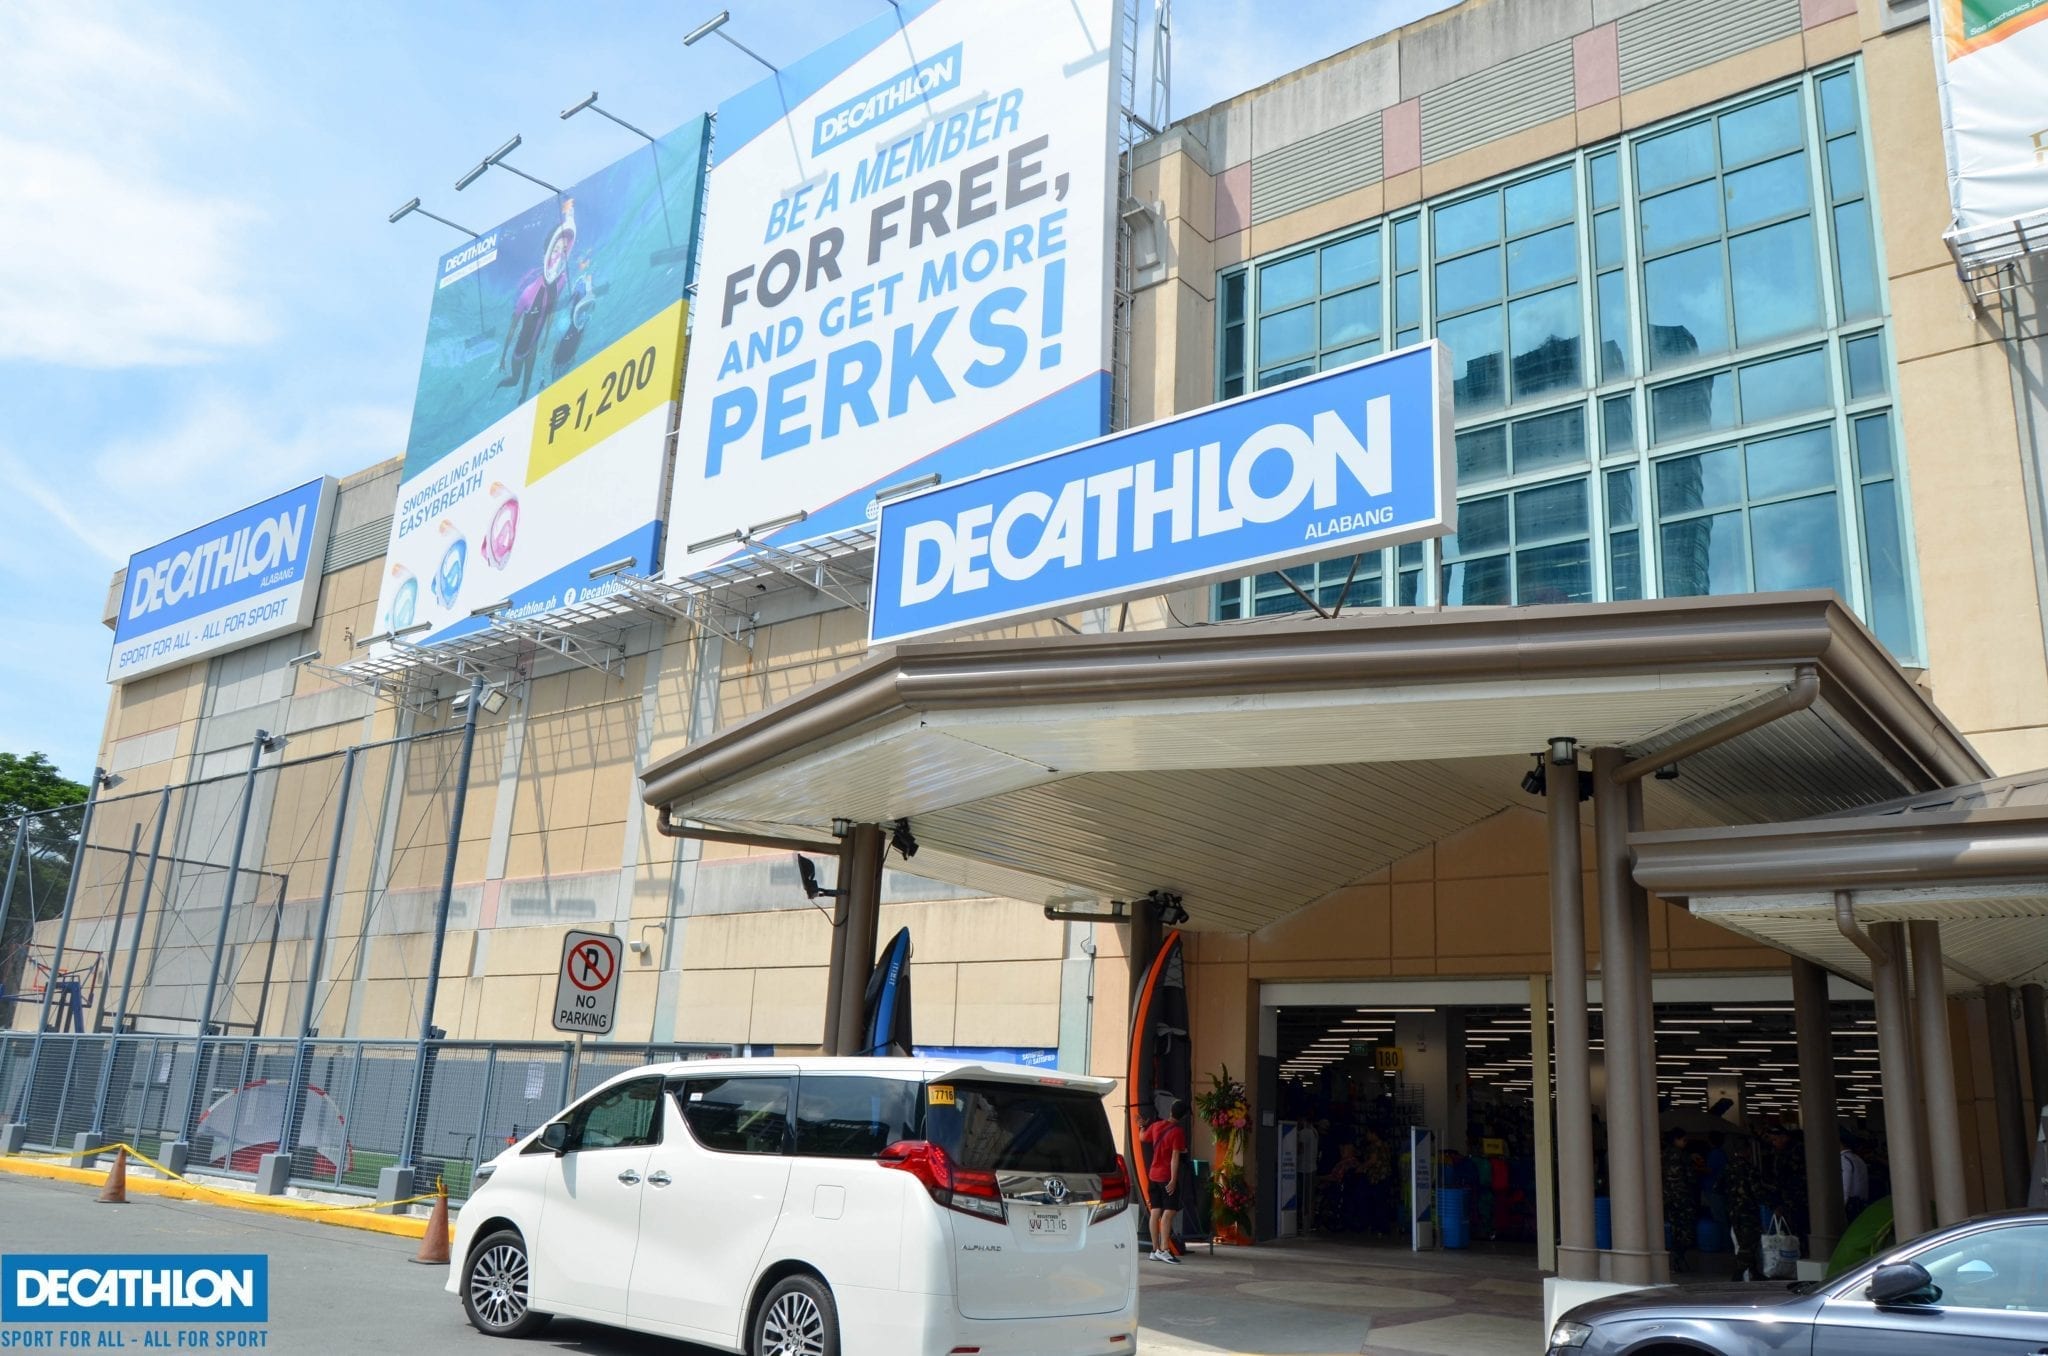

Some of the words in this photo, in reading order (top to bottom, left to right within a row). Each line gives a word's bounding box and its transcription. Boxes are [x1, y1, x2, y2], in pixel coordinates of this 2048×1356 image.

[1970, 24, 1987, 36] See
[1988, 2, 2031, 27] mechanics
[819, 56, 954, 145] DECATHLON
[763, 184, 814, 244] BE
[815, 171, 840, 221] A
[849, 87, 1024, 206] MEMBER
[721, 226, 844, 328] FOR
[867, 134, 1071, 267] FREE,
[717, 315, 804, 381] AND
[819, 272, 903, 338] GET
[917, 208, 1068, 303] MORE
[704, 258, 1066, 479] PERKS!
[398, 471, 483, 540] EASYBREATH
[401, 461, 470, 516] SNORKELING
[471, 437, 505, 477] MASK
[900, 394, 1392, 608] DECATHLON
[1304, 505, 1394, 541] ALABANG
[128, 504, 307, 621] DECATHLON
[260, 567, 294, 588] ALABANG
[119, 644, 152, 669] SPORT
[151, 637, 172, 658] FOR
[173, 631, 191, 651] ALL
[201, 624, 221, 642] ALL
[223, 615, 246, 636] FOR
[247, 598, 288, 627] SPORT
[560, 1010, 607, 1028] PARKING
[575, 995, 597, 1009] NO
[934, 1089, 954, 1101] 7716
[1044, 1218, 1067, 1230] 7716
